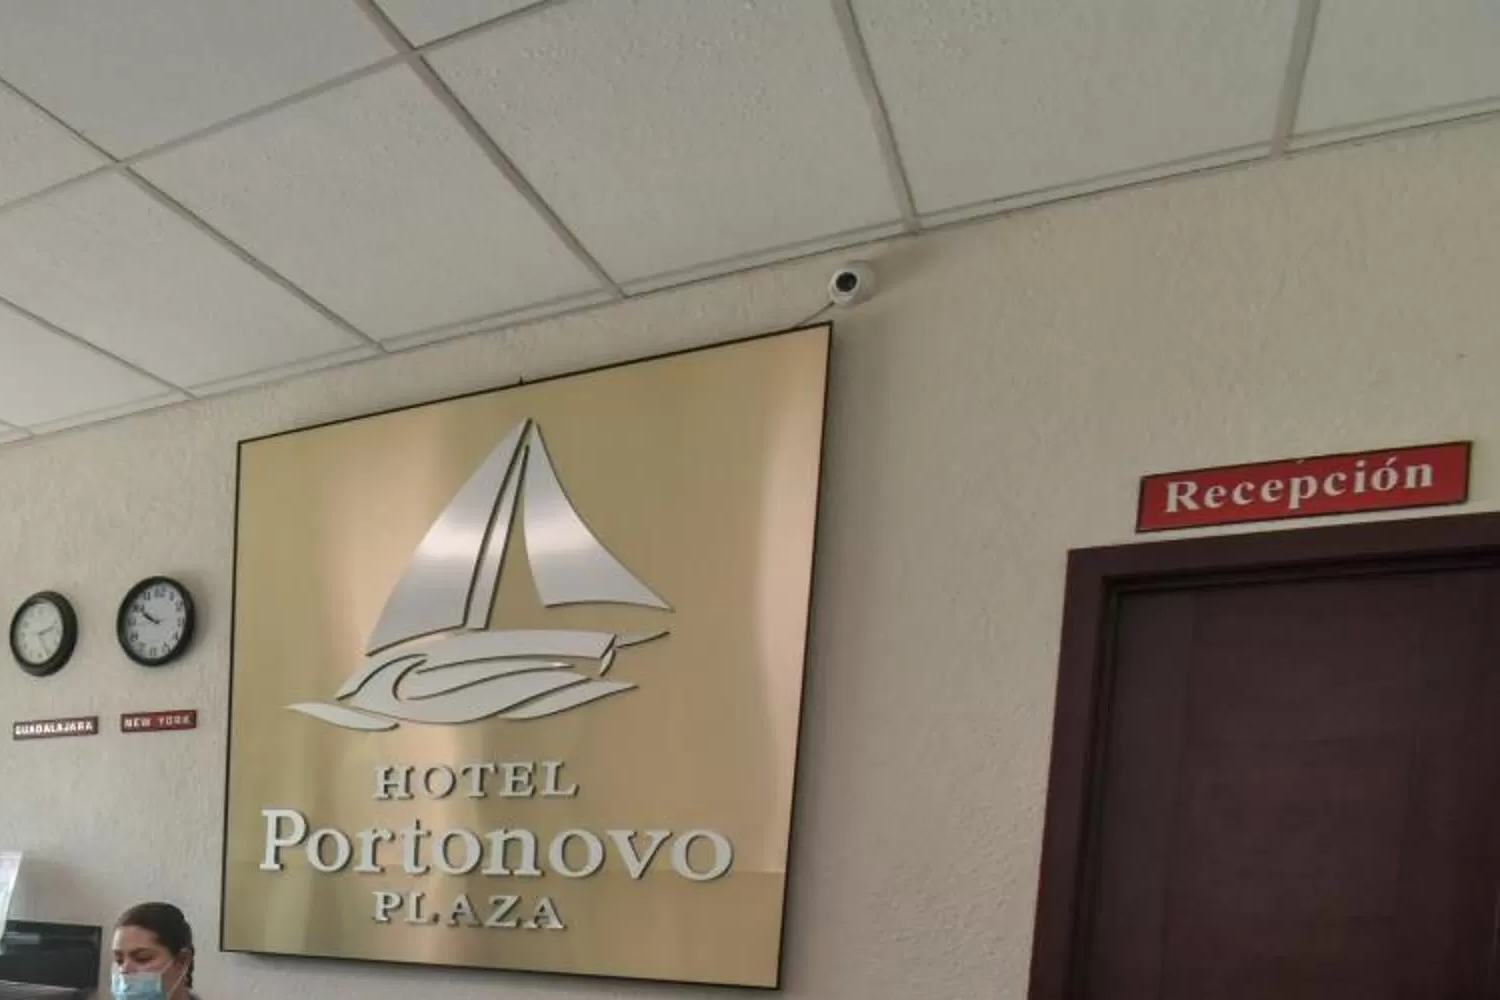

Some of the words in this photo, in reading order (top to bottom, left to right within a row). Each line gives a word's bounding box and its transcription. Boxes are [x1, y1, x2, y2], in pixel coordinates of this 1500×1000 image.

[1162, 456, 1434, 514] Recepción
[14, 720, 94, 735] GUADALAJARA
[123, 717, 152, 728] NEW
[157, 714, 191, 726] YORK
[372, 760, 580, 800] HOTEL
[259, 808, 734, 881] Portonovo
[372, 890, 567, 931] PLAZA
